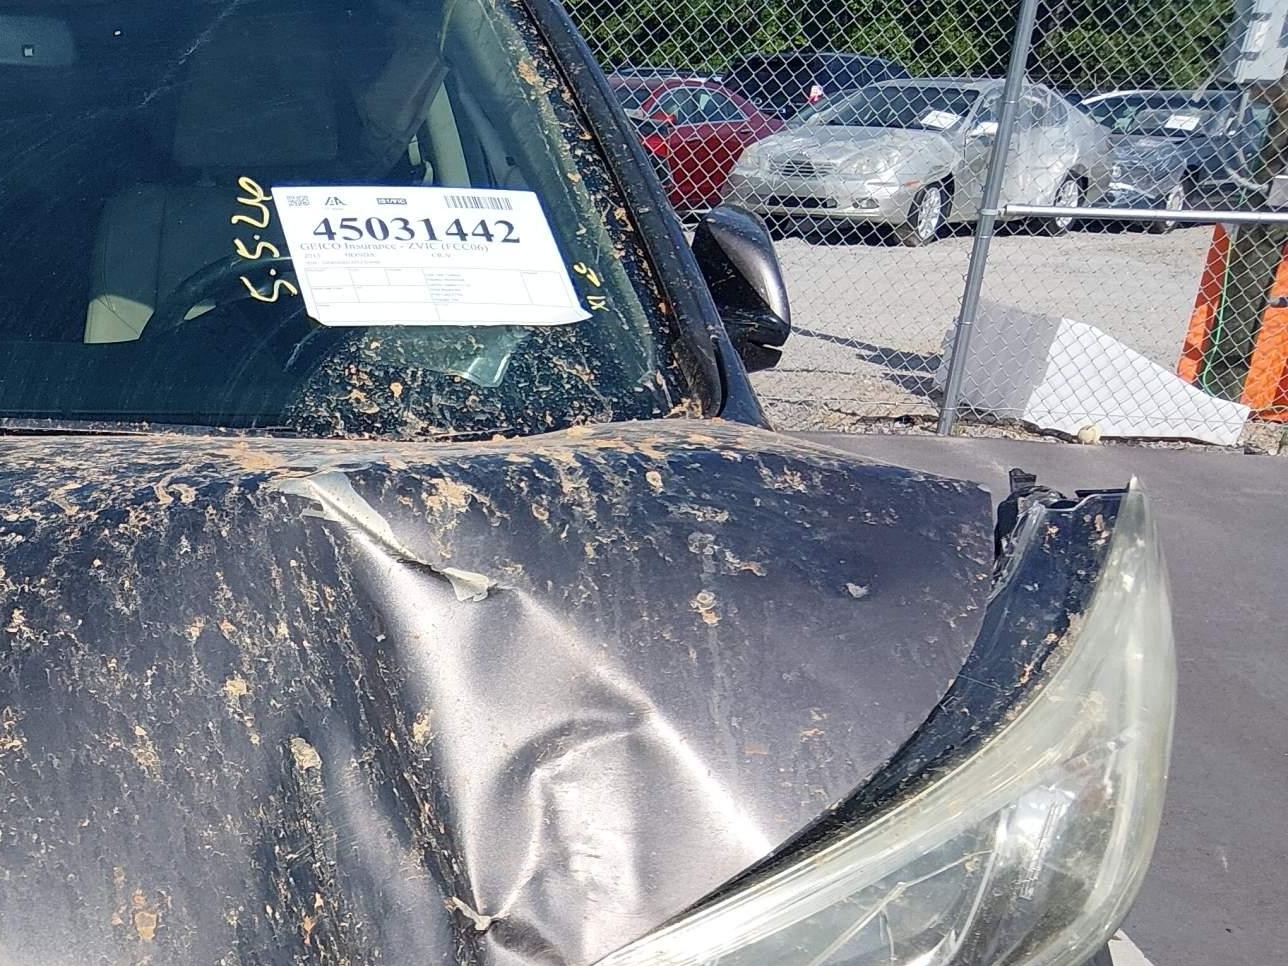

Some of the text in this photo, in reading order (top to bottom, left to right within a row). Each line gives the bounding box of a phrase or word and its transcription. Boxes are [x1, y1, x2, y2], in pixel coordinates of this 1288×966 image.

[313, 216, 520, 243] 45031442
[300, 242, 341, 251] GEICO
[344, 242, 397, 251] Insurance
